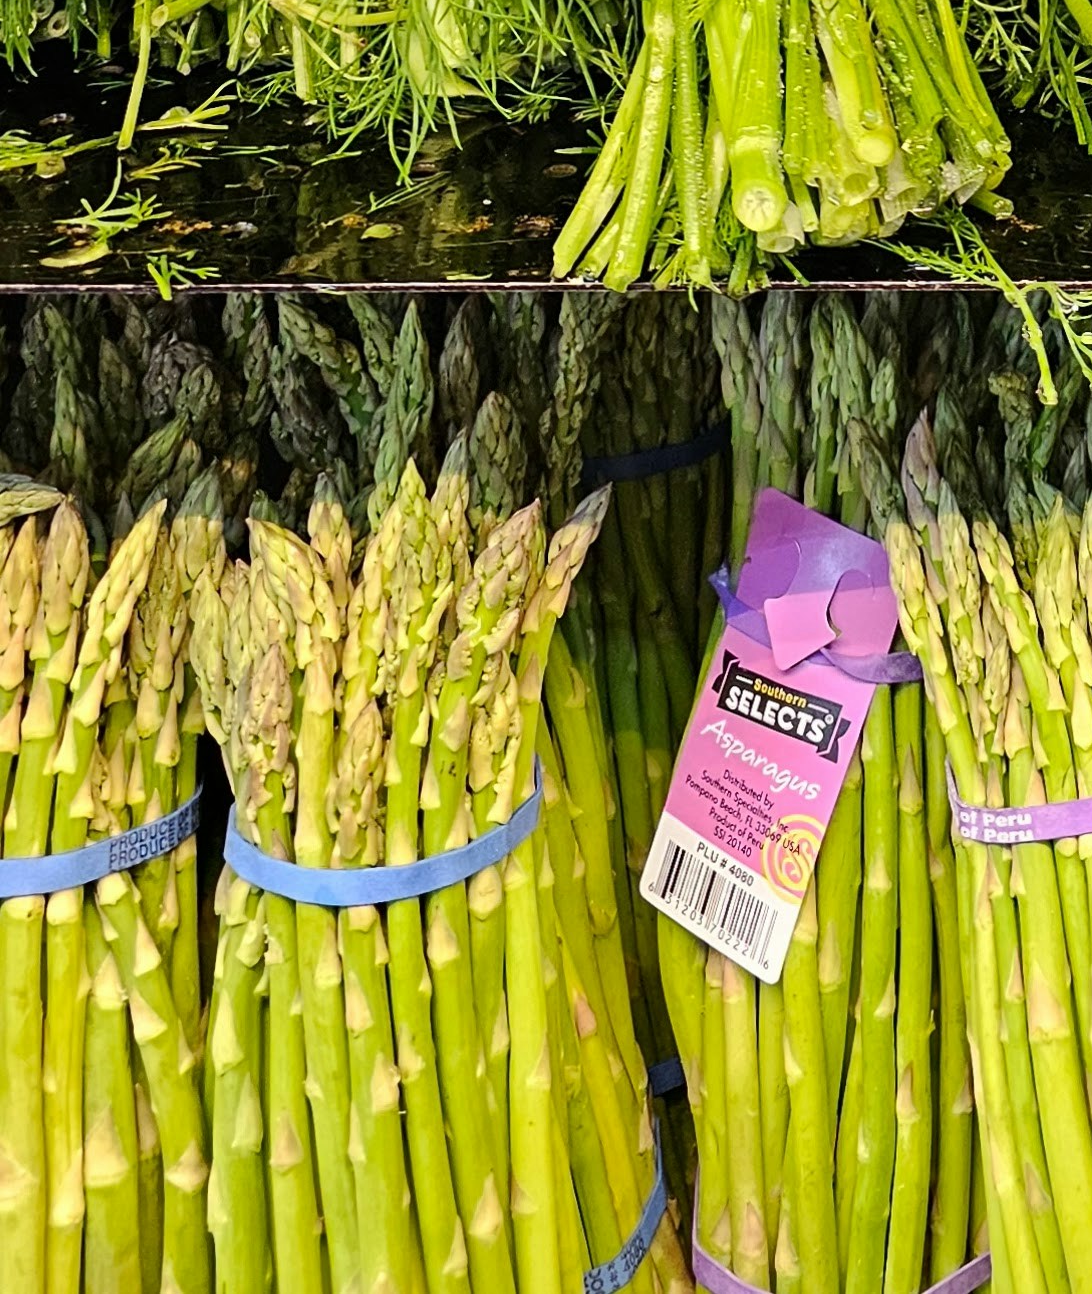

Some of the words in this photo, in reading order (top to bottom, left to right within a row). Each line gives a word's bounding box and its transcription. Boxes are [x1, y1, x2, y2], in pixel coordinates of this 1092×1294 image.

[754, 678, 808, 708] Southern
[701, 719, 820, 800] Asparagus
[701, 770, 732, 798] Southern
[723, 769, 763, 802] Distributed
[764, 793, 774, 810] by
[685, 774, 719, 804] Pompano
[720, 798, 743, 823] Beach,
[745, 815, 753, 828] FL
[755, 821, 782, 844] 33069
[782, 838, 801, 855] USA
[709, 807, 736, 832] Product
[737, 827, 747, 838] of
[747, 834, 764, 850] Peru
[960, 810, 977, 824] of
[982, 813, 1032, 827] Peru
[109, 816, 176, 853] PRODUCE
[109, 832, 176, 869] PRODUCE
[713, 825, 726, 841] SSI
[726, 835, 752, 858] 20140
[960, 826, 978, 839] of
[983, 828, 1034, 842] Peru
[696, 841, 719, 864] PLU
[720, 858, 728, 869] #
[729, 864, 754, 887] 4080
